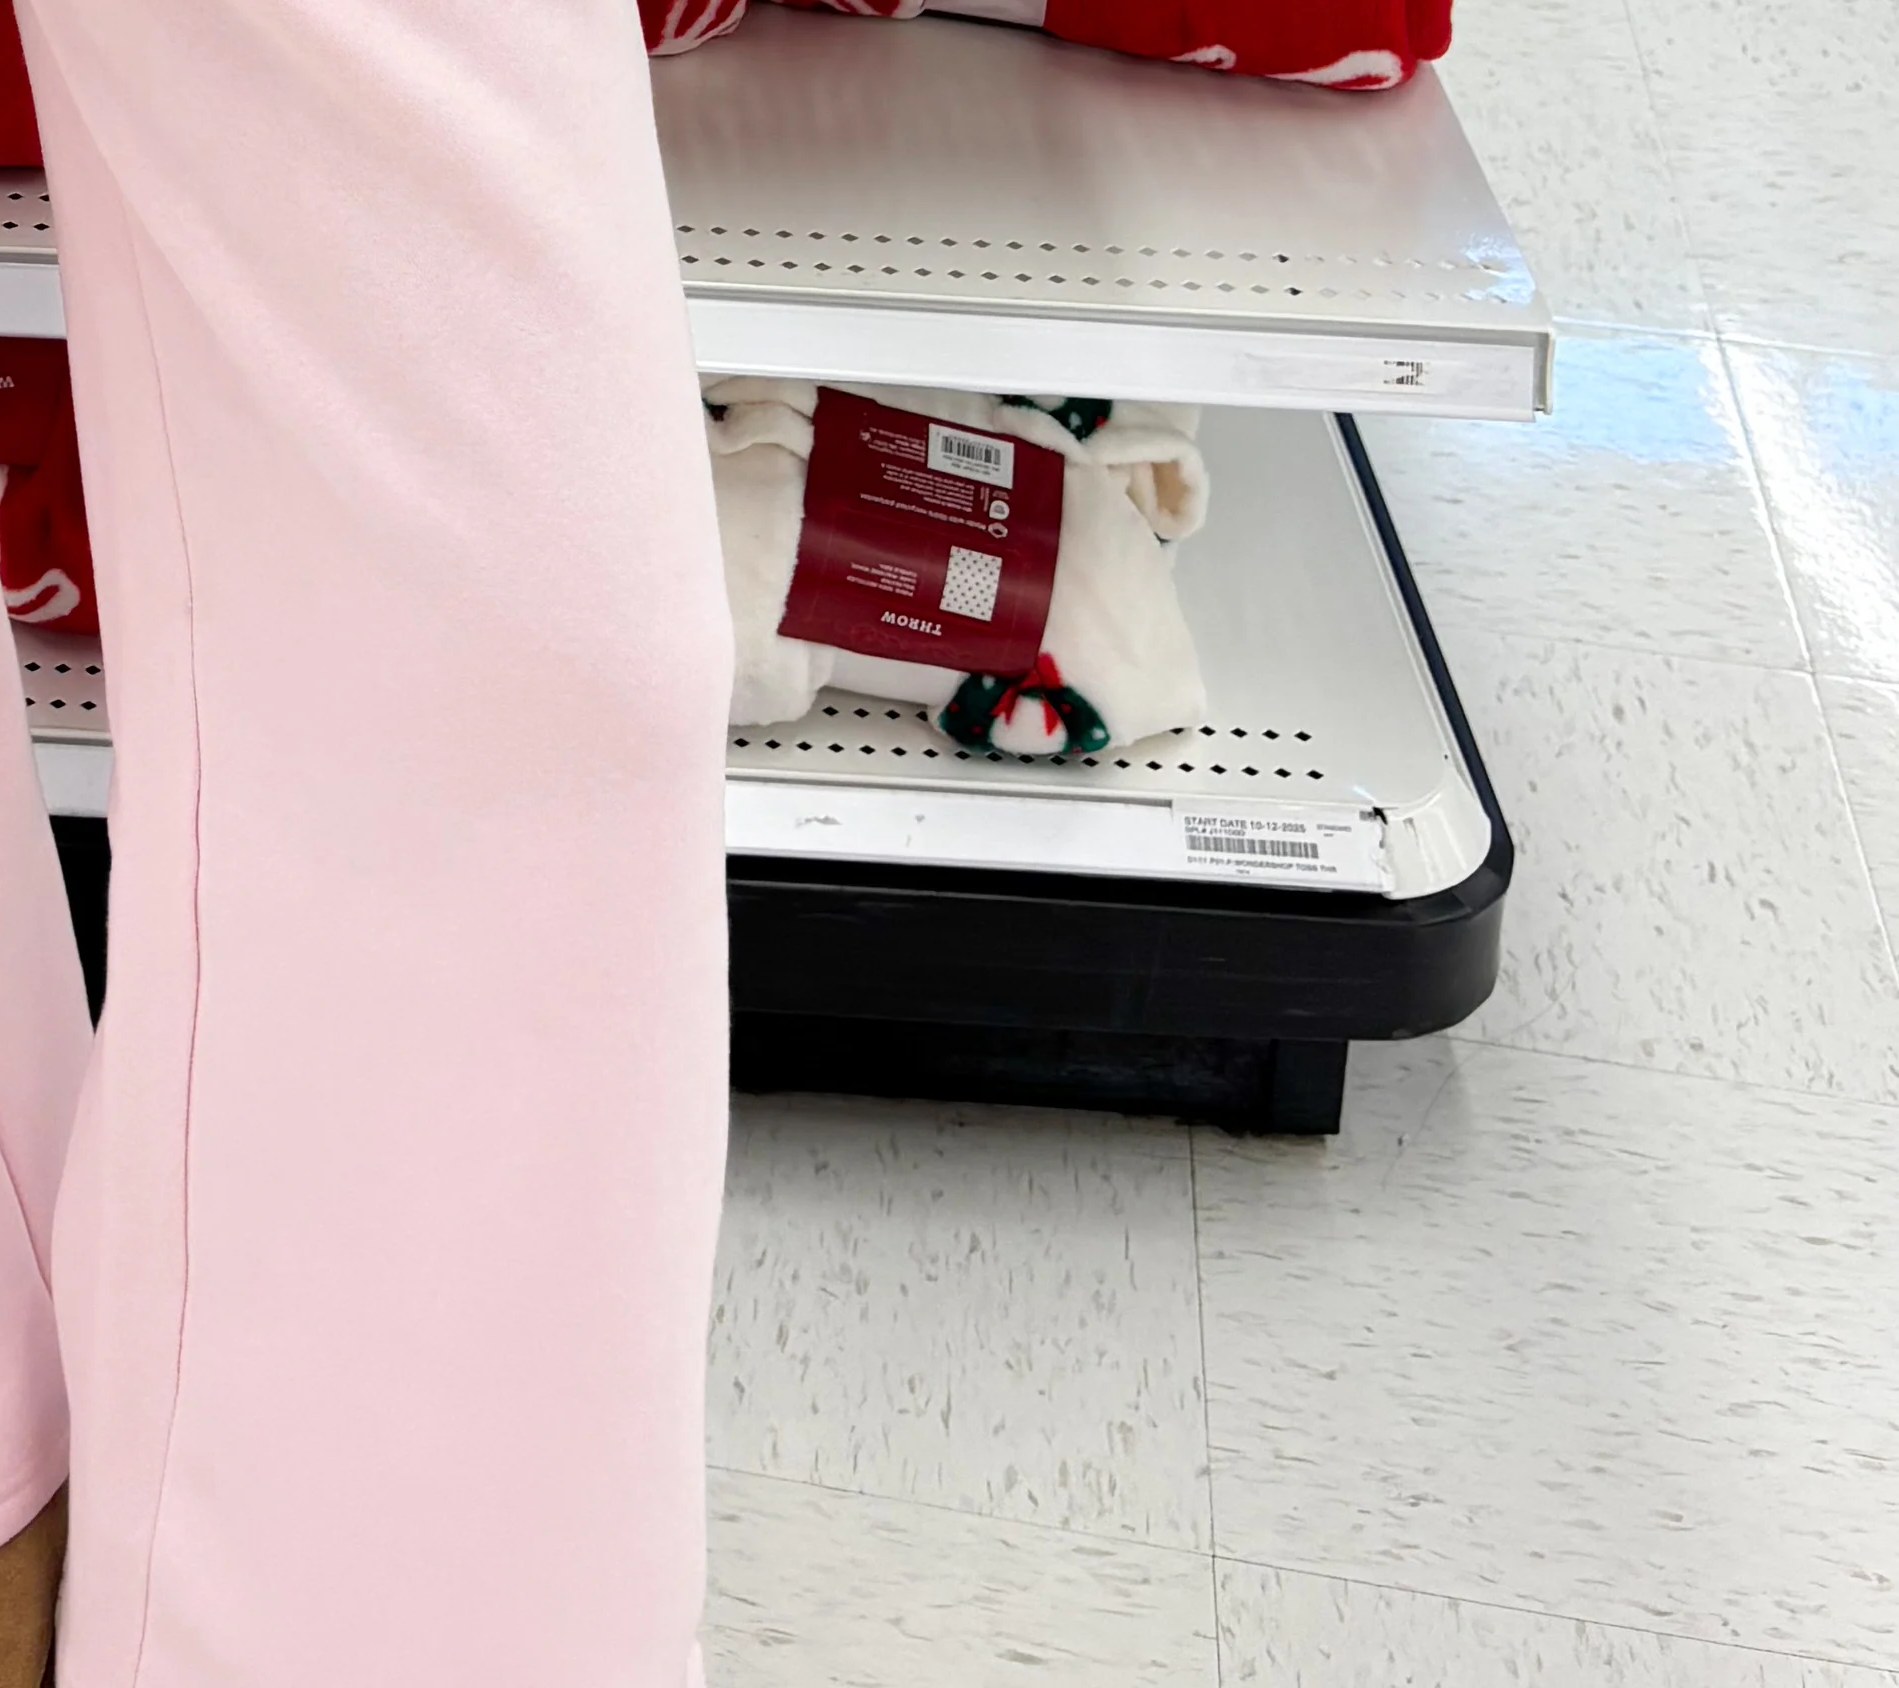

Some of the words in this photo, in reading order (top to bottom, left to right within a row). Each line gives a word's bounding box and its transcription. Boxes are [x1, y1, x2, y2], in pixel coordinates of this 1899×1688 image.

[879, 610, 942, 637] THROW
[1184, 816, 1218, 827] START
[1219, 818, 1248, 830] DATE
